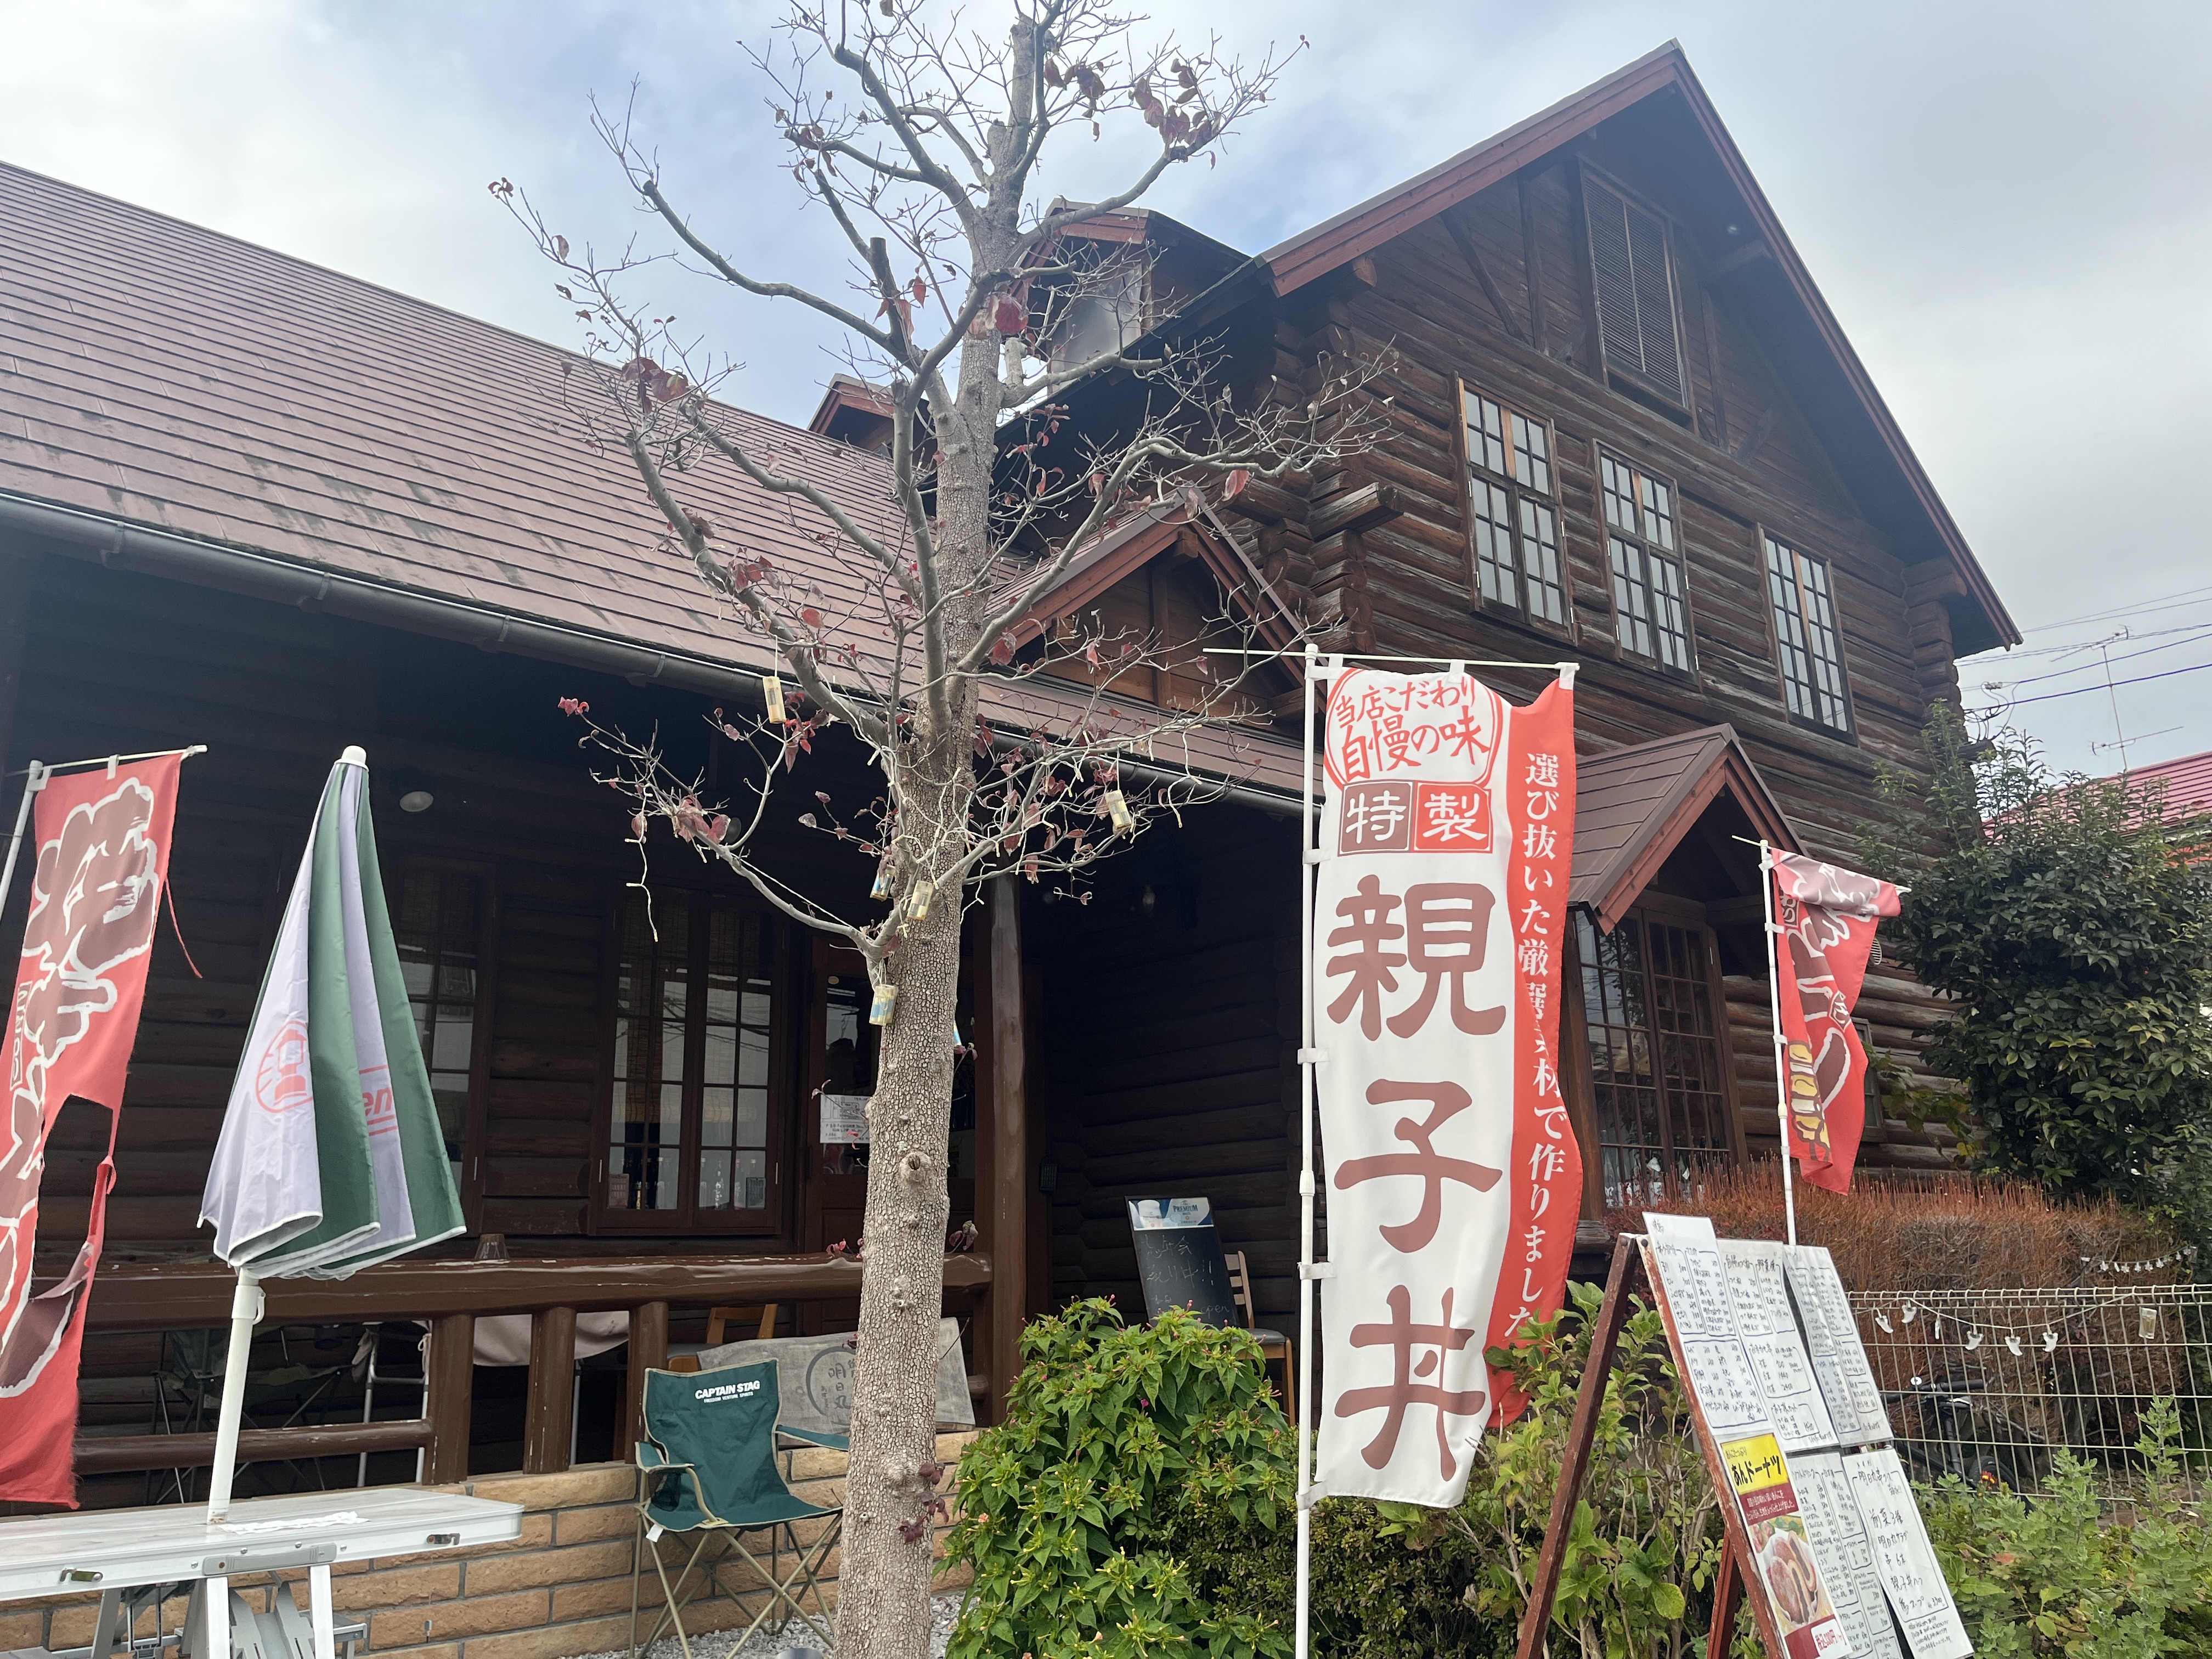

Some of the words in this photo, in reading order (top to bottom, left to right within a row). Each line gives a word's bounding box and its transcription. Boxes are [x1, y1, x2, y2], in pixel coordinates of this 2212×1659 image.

[1335, 678, 1475, 727] 当店こだわり
[1342, 706, 1490, 781] 自慢の味
[1345, 791, 1487, 844] 特製
[1504, 752, 1567, 1337] 選び抜いた厳選材で作りました
[1327, 874, 1506, 1481] 親子丼
[695, 1384, 736, 1399] CAPTAIN
[737, 1380, 760, 1393] STAG
[1731, 1455, 1781, 1486] あんドーナツ
